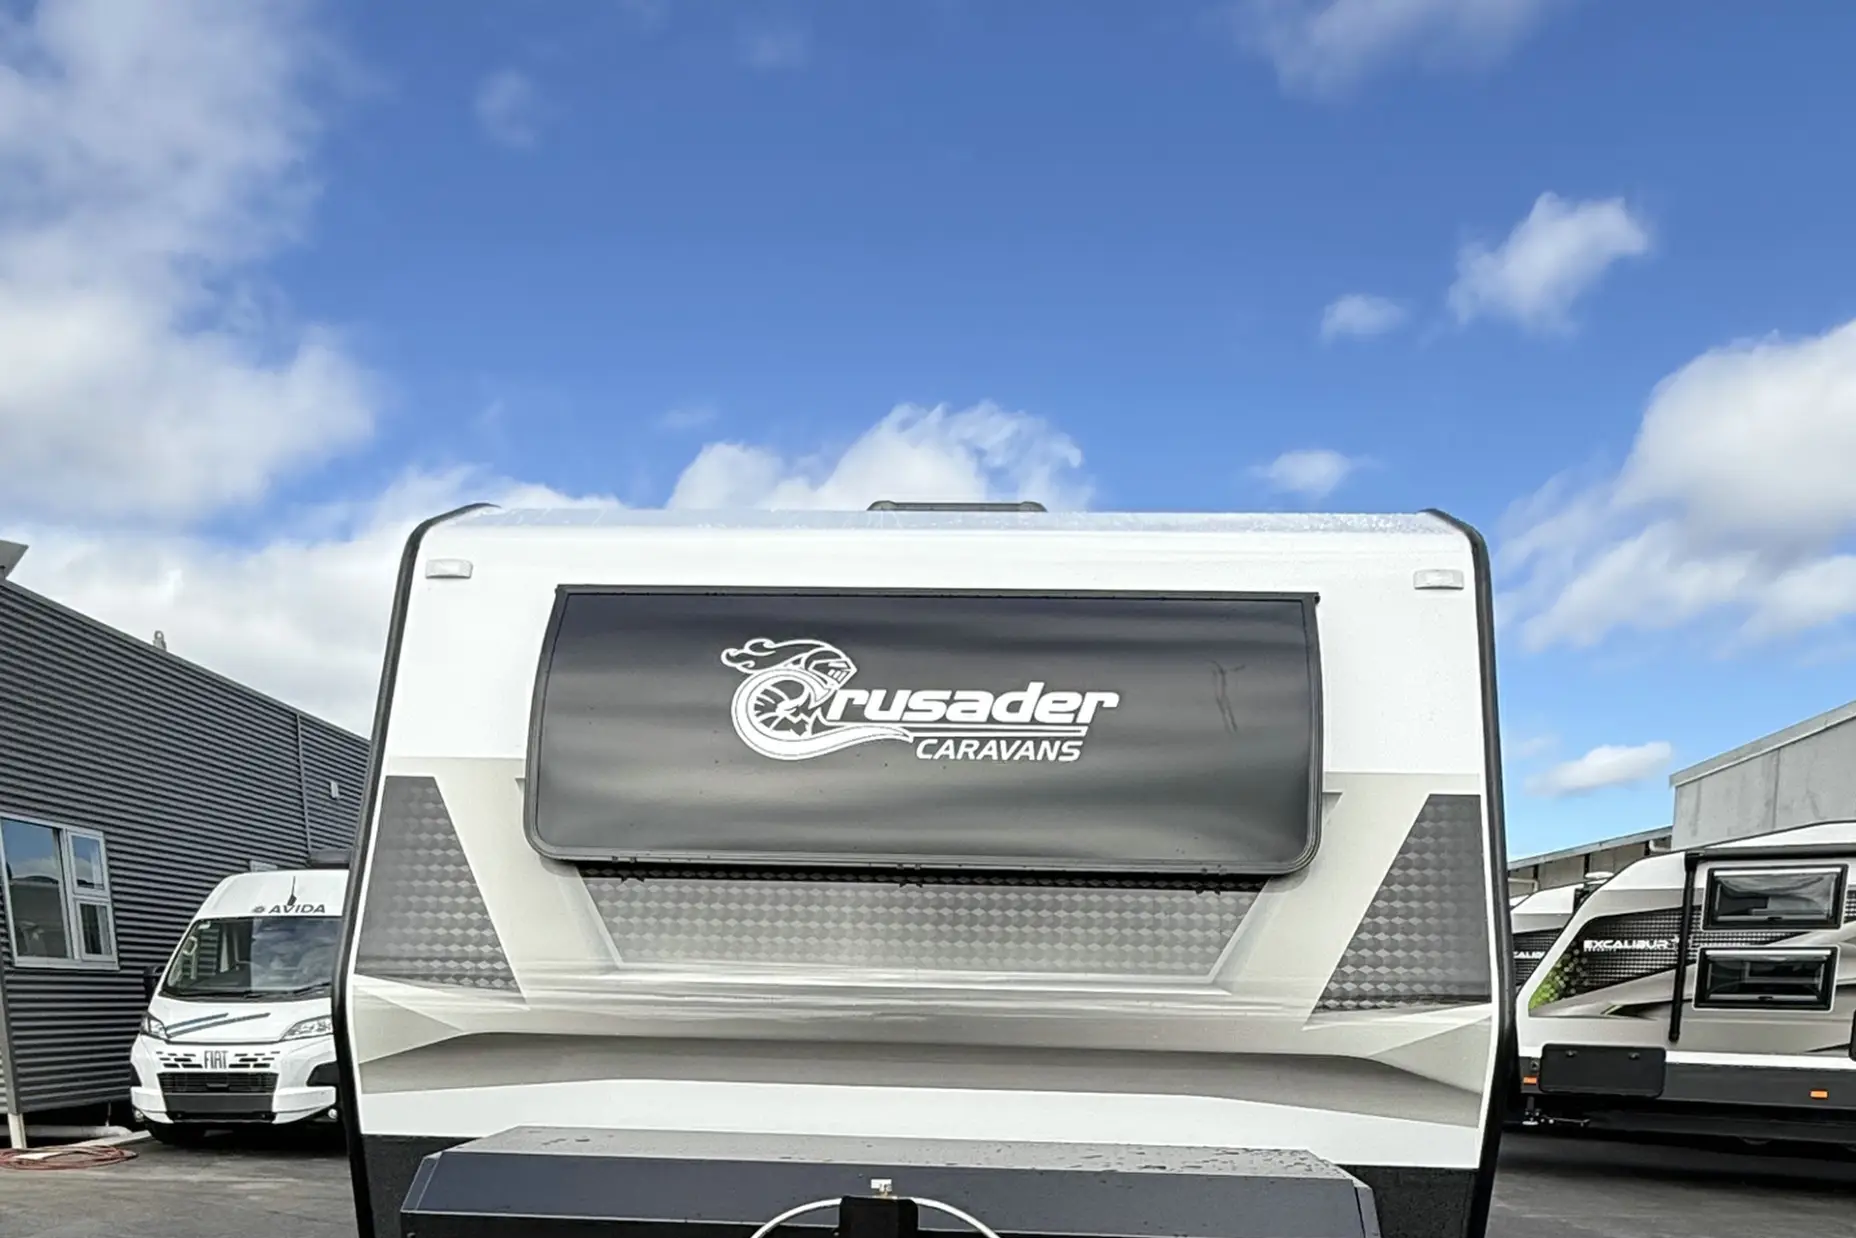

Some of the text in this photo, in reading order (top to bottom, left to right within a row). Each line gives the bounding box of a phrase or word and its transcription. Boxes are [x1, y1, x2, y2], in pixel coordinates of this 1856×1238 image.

[915, 738, 1084, 762] CARAVANS
[268, 904, 326, 914] AVIDA
[1583, 939, 1669, 950] EXCALIBUR
[204, 1050, 229, 1069] FIAT
